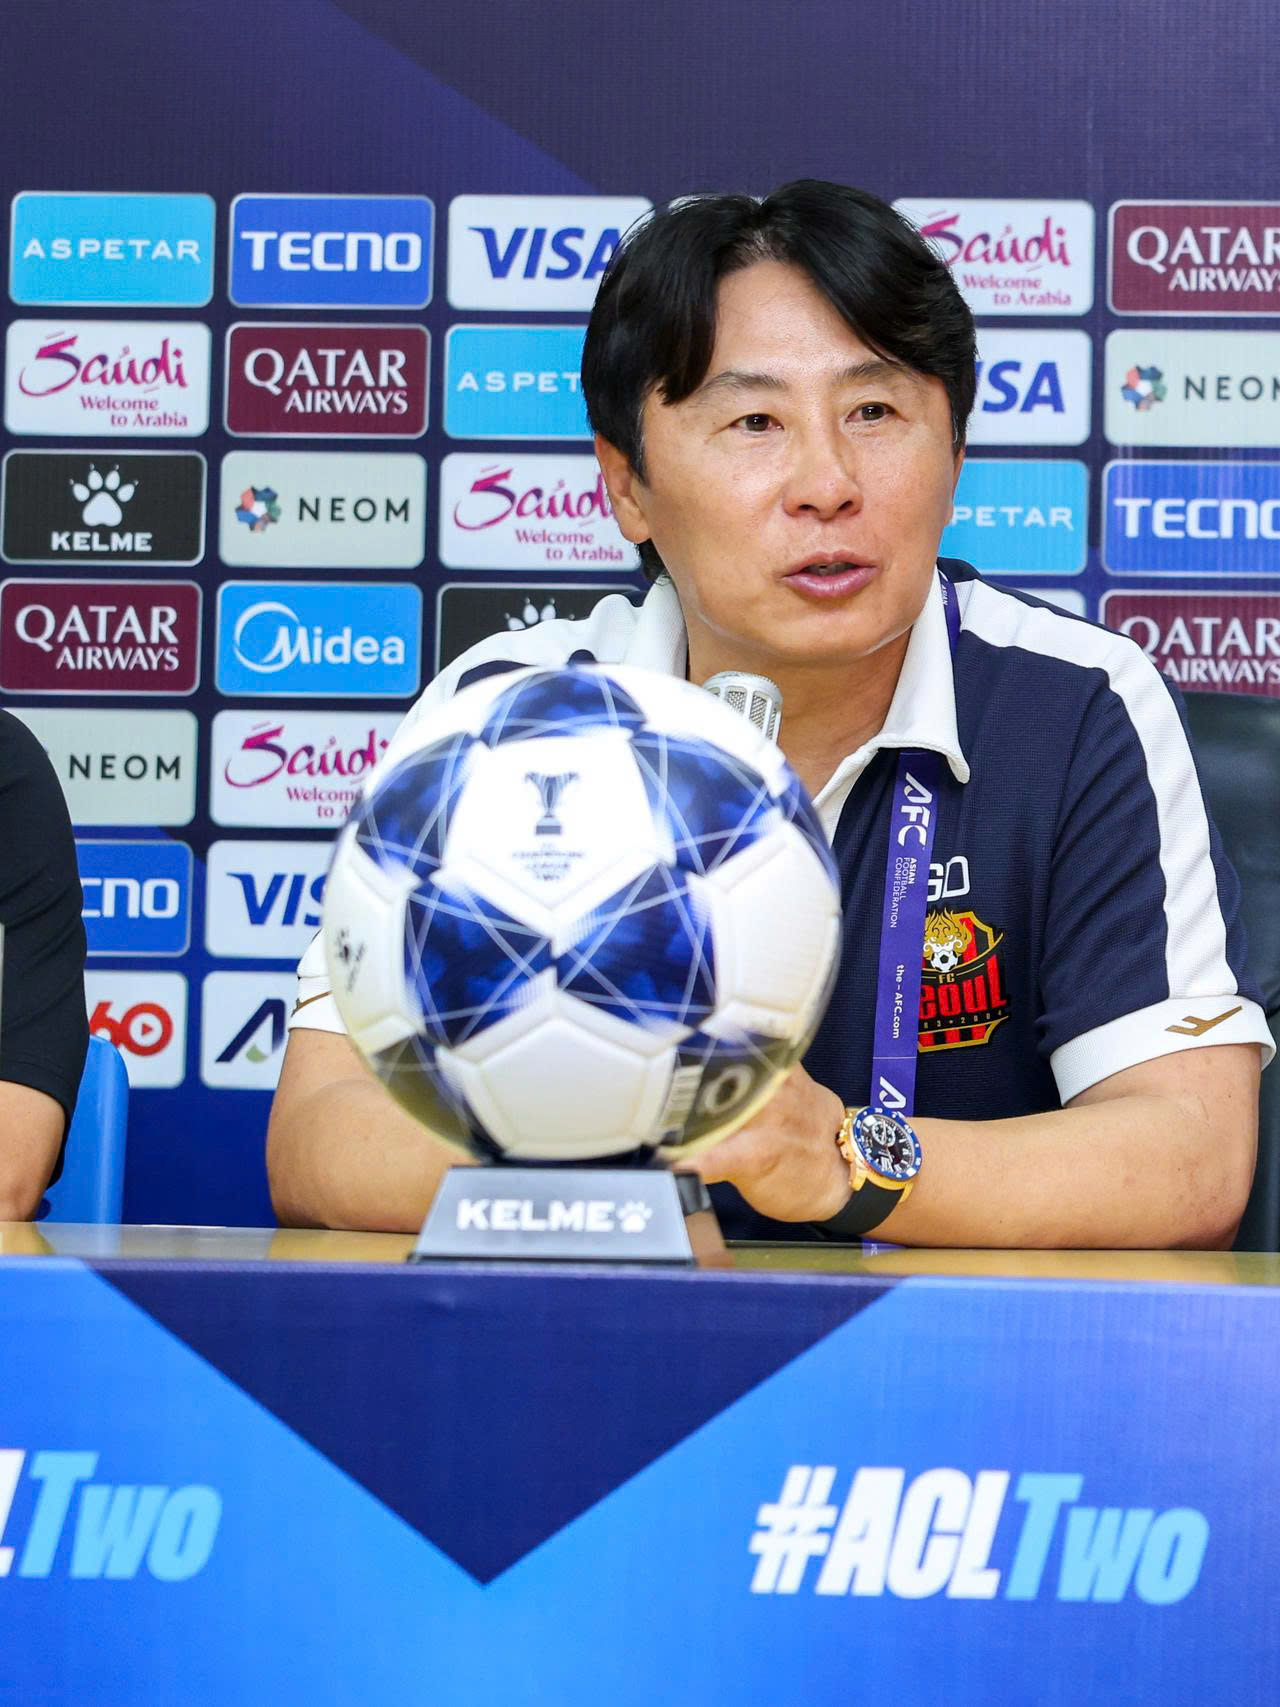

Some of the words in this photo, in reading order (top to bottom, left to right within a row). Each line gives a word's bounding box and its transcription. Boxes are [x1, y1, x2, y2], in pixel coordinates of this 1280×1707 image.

[23, 238, 202, 263] ASPETAR
[241, 231, 422, 273] TECNO
[963, 275, 1042, 289] Welcome
[994, 292, 1011, 306] to
[1016, 291, 1072, 306] Arabia
[243, 348, 408, 392] QATAR
[457, 372, 580, 393] ASPET
[975, 360, 1065, 413] SA
[80, 396, 159, 411] Welcome
[284, 391, 408, 415] AIRWAYS
[111, 413, 128, 427] to
[132, 412, 188, 427] Arabia
[298, 497, 410, 523] NEOM
[454, 465, 612, 531] Saud
[951, 506, 1074, 531] PETAR
[50, 531, 152, 552] KELME
[515, 529, 594, 545] Welcome
[545, 547, 563, 561] to
[568, 546, 624, 561] Arabia
[15, 605, 180, 649] QATAR
[56, 647, 180, 671] AIRWAYS
[68, 754, 181, 781] NEOM
[317, 805, 334, 818] to
[897, 771, 932, 847] AFC
[900, 857, 911, 900] FOOTBALL
[908, 857, 917, 884] ASIAN
[226, 872, 329, 926] VIS
[890, 857, 903, 928] CONFEDERATION
[938, 973, 955, 984] FC
[457, 1199, 613, 1232] KELME
